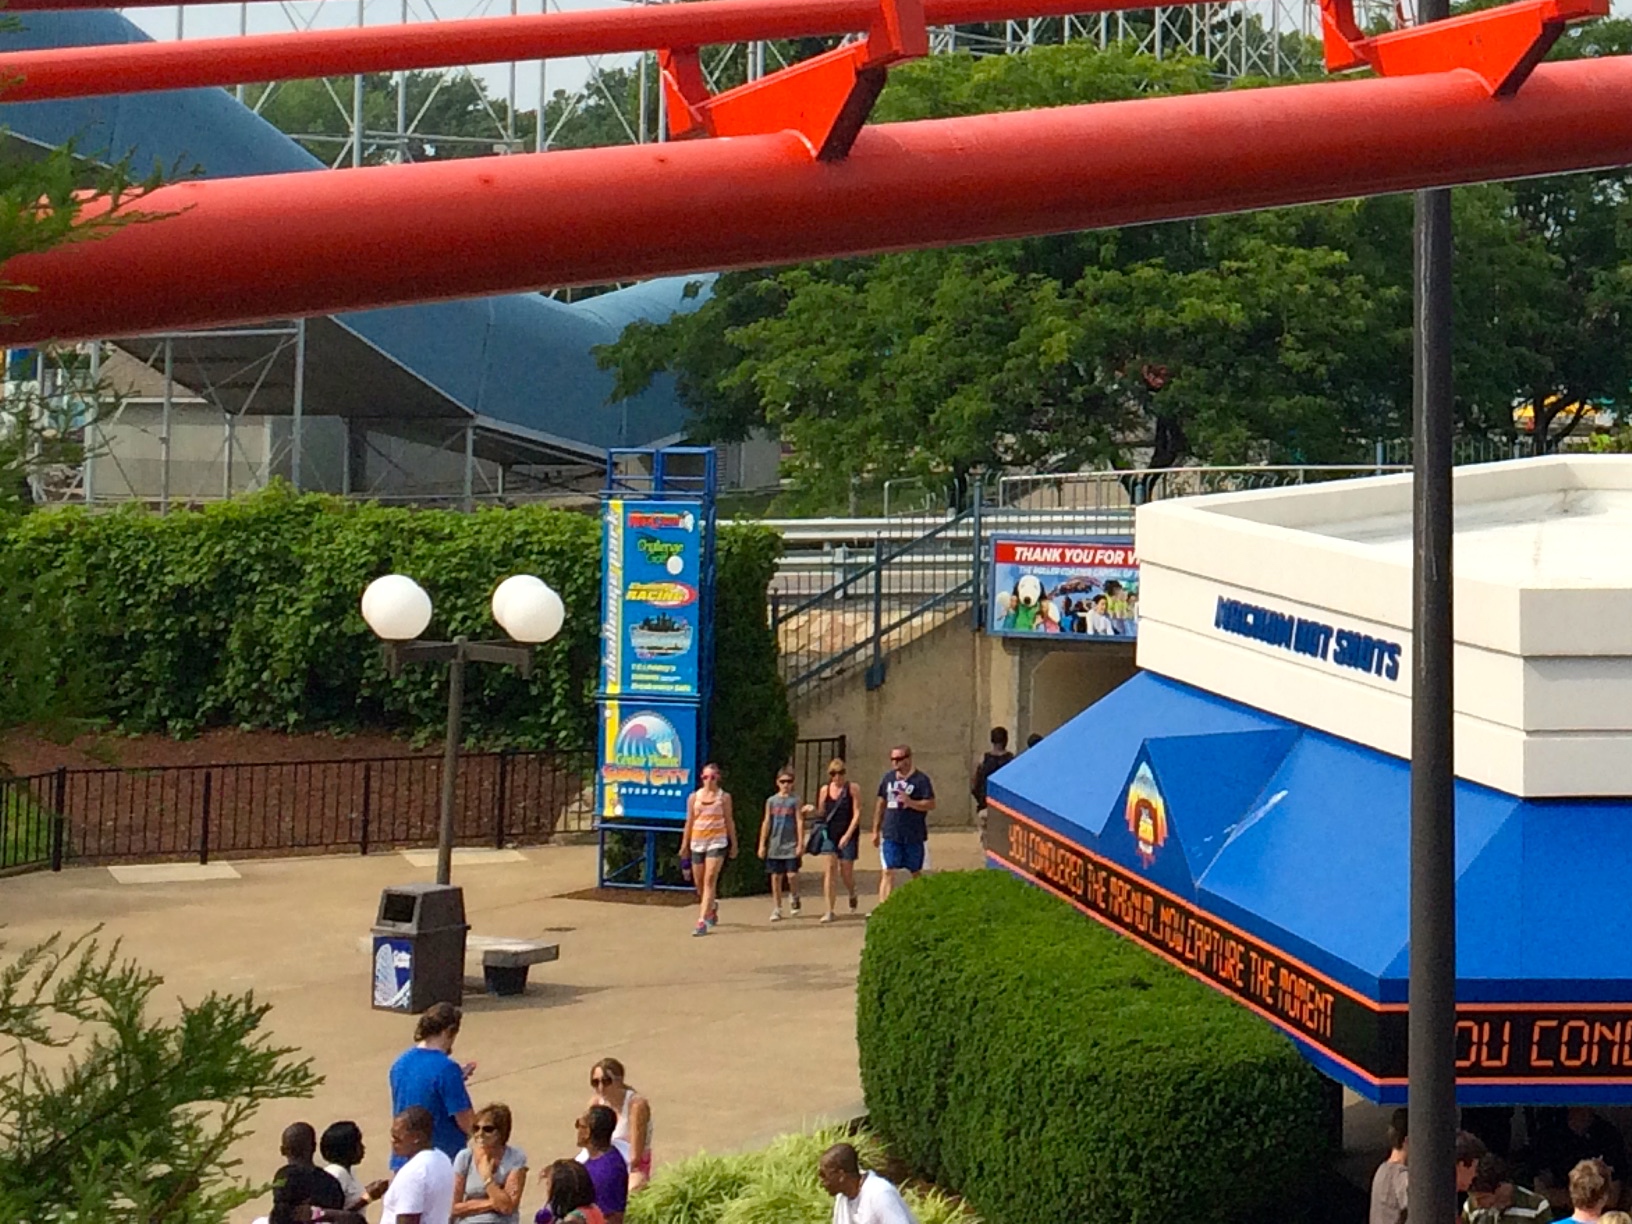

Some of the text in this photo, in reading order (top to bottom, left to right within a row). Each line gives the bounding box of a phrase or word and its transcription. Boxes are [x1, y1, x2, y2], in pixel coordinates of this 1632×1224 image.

[1014, 547, 1062, 562] THANK
[1064, 548, 1095, 563] YOU
[1094, 550, 1125, 564] FOR
[625, 589, 687, 601] RACING
[1332, 627, 1402, 682] SHOTS
[616, 753, 680, 768] Cedar Point
[650, 768, 690, 787] CITY
[1008, 823, 1028, 863] YOU
[1029, 832, 1084, 895] CONQUERED
[1087, 863, 1107, 909] THE
[1185, 918, 1245, 988] CAPTURE
[1250, 951, 1275, 1005] THE
[1278, 967, 1335, 1038] MOMENT
[1455, 1019, 1511, 1067] OU
